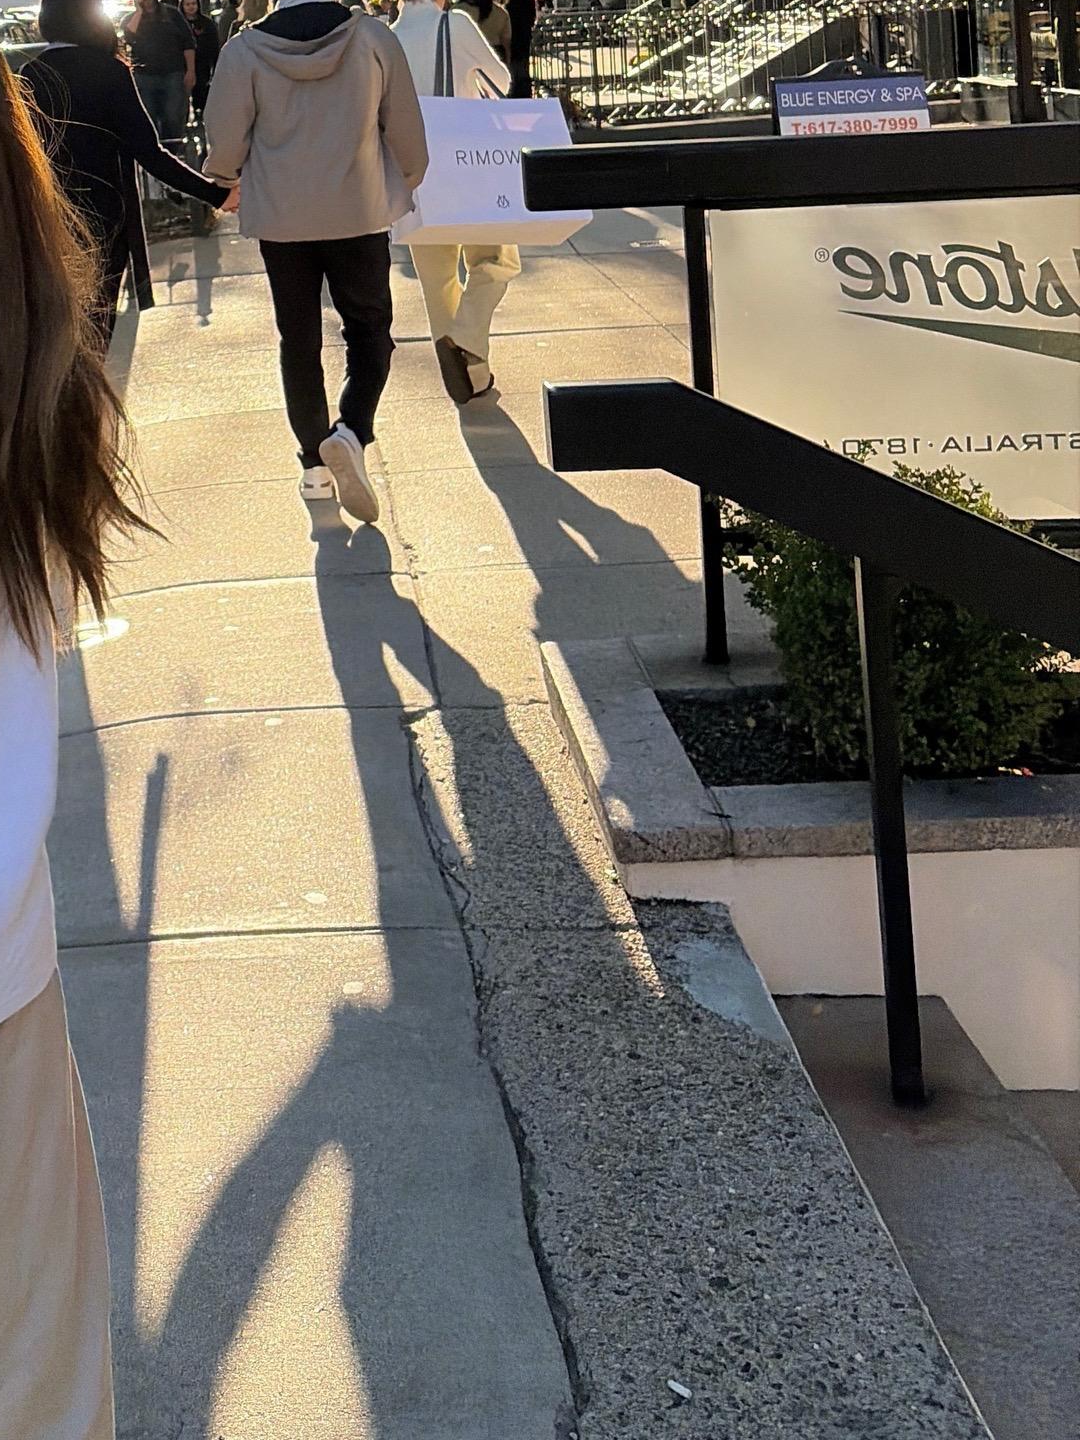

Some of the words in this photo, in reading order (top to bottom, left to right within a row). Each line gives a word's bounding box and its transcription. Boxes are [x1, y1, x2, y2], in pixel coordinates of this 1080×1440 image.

[781, 91, 815, 108] BLUE
[819, 88, 877, 106] ENERGY
[880, 87, 893, 103] &
[896, 86, 924, 102] SPA
[791, 116, 918, 136] T:617-380-7999
